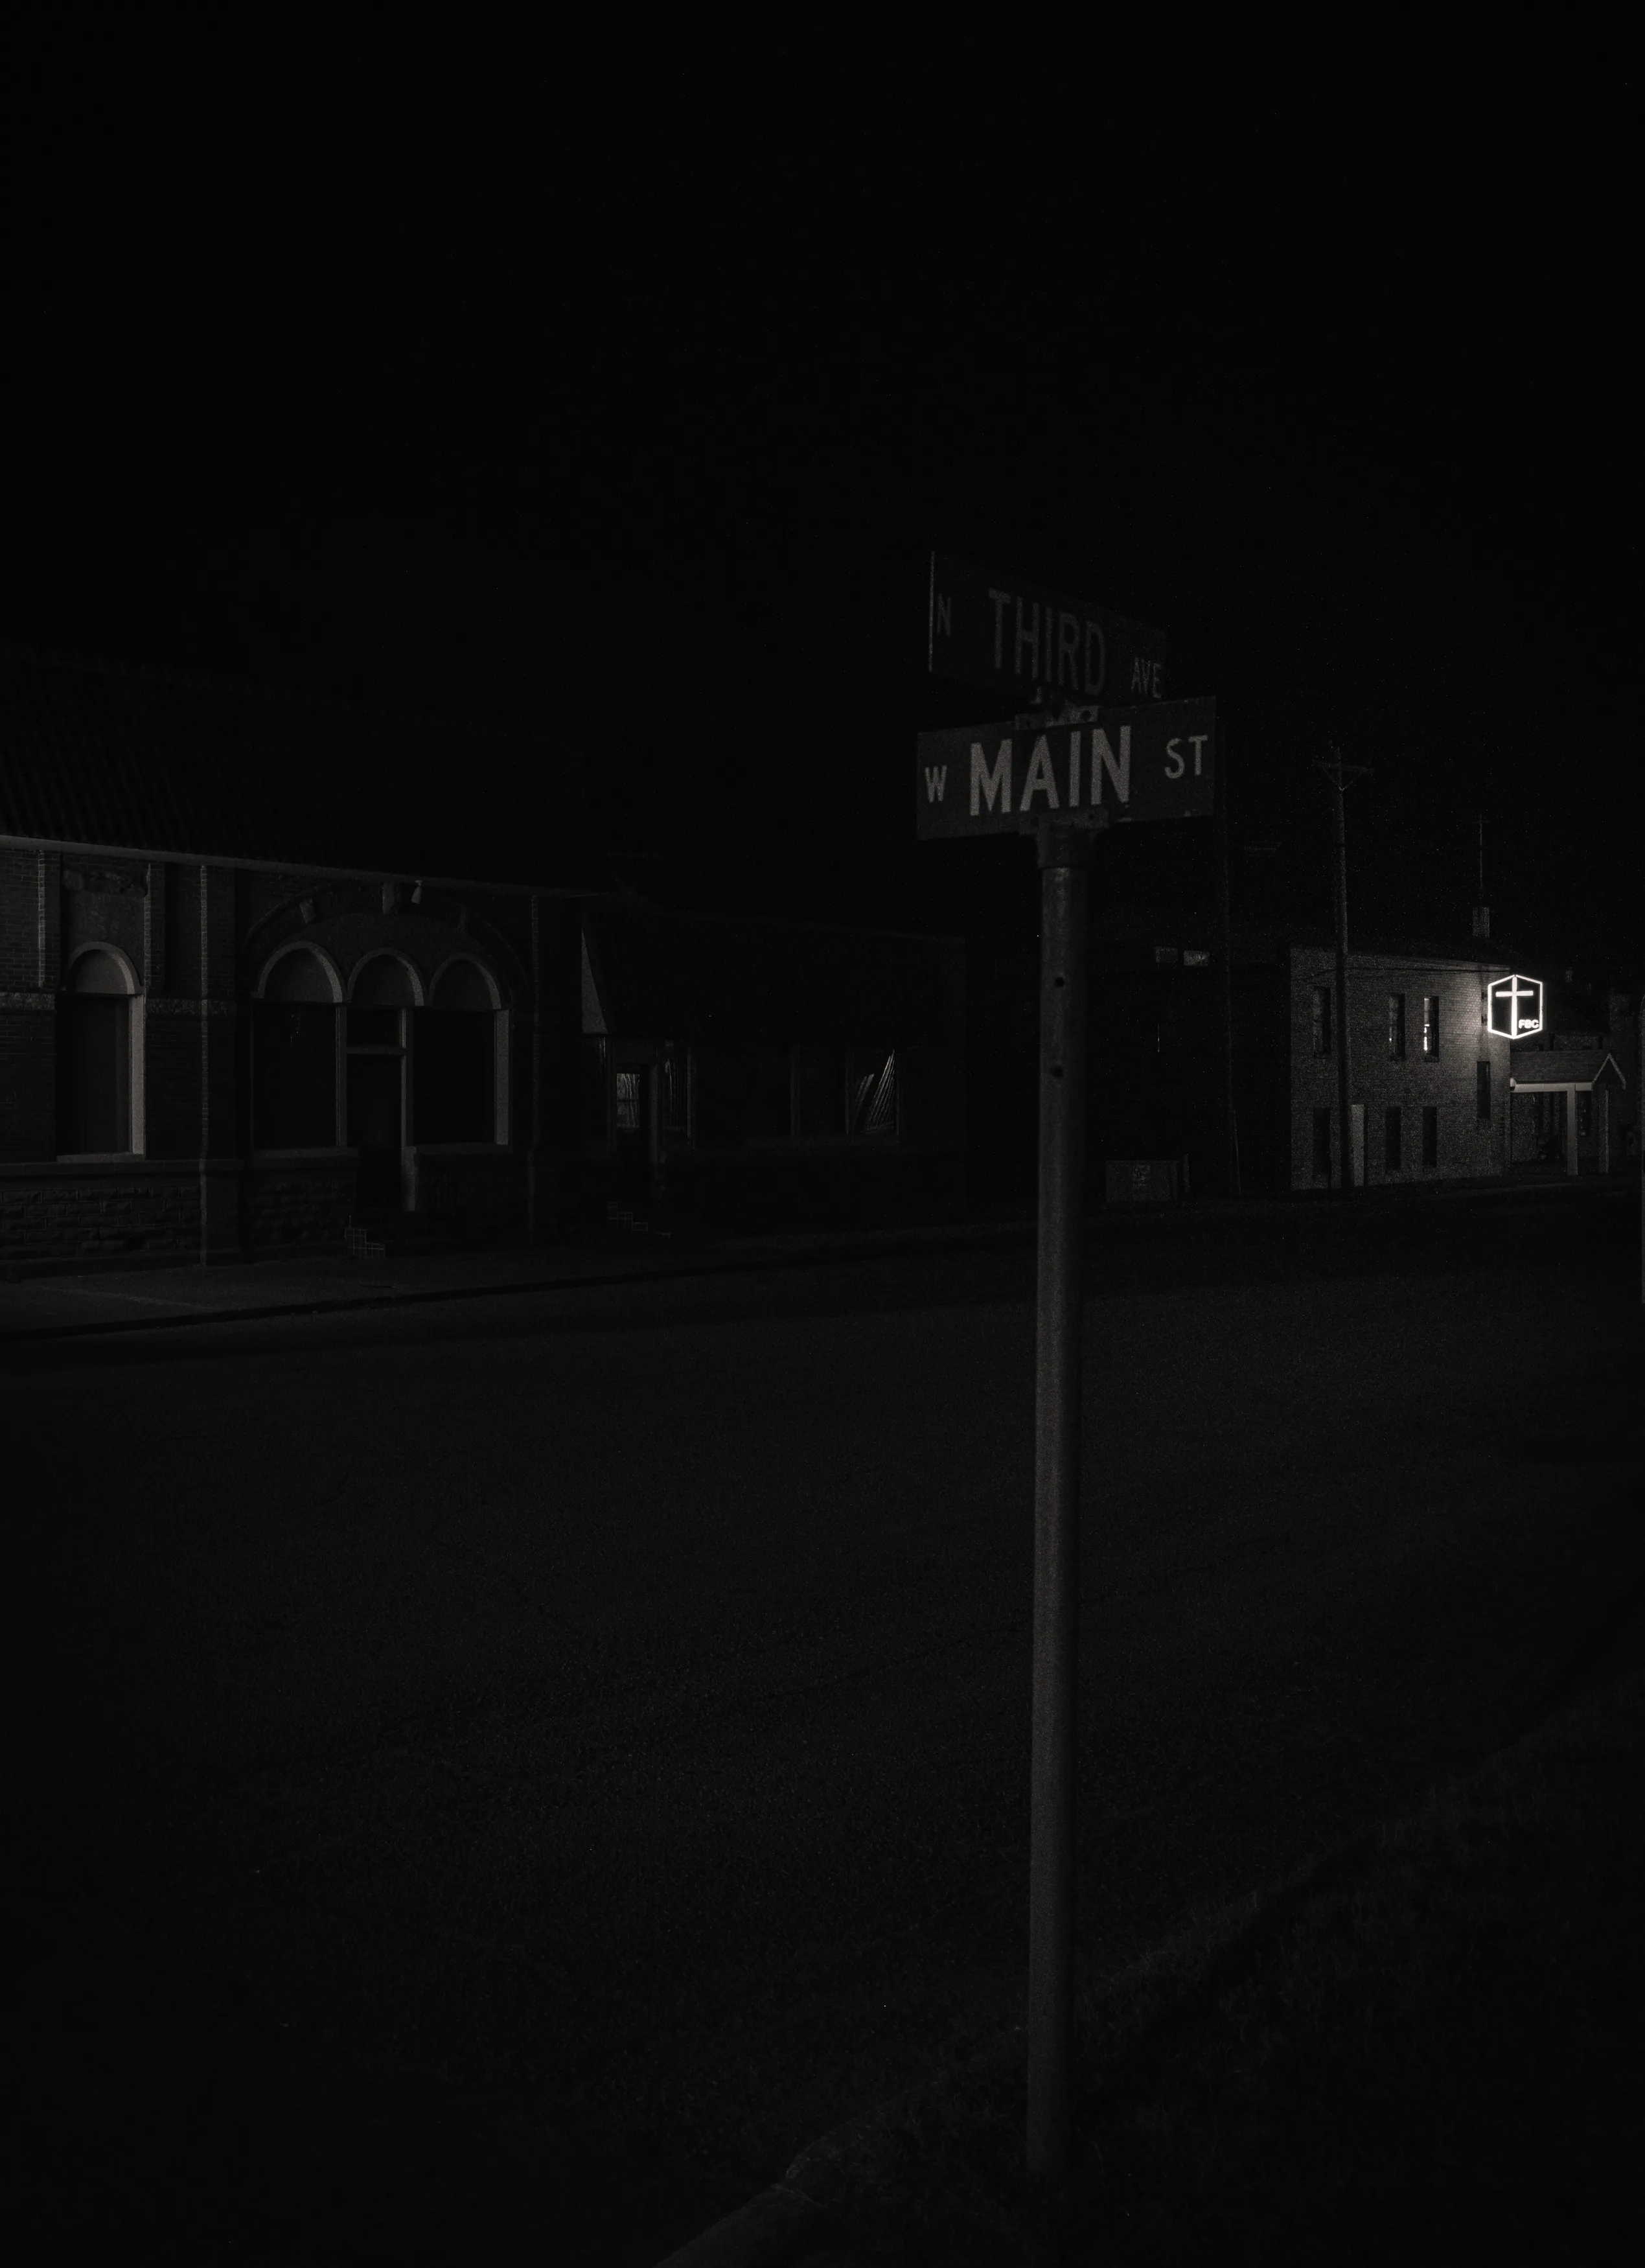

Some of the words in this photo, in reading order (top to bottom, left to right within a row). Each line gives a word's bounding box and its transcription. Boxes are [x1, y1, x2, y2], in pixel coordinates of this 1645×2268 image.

[937, 593, 952, 638] N
[987, 587, 1107, 696] THIRD
[1131, 656, 1164, 699] AVE
[924, 765, 948, 804] W
[969, 725, 1132, 816] MAIN
[1164, 734, 1209, 780] ST
[1518, 1019, 1539, 1029] FBC
